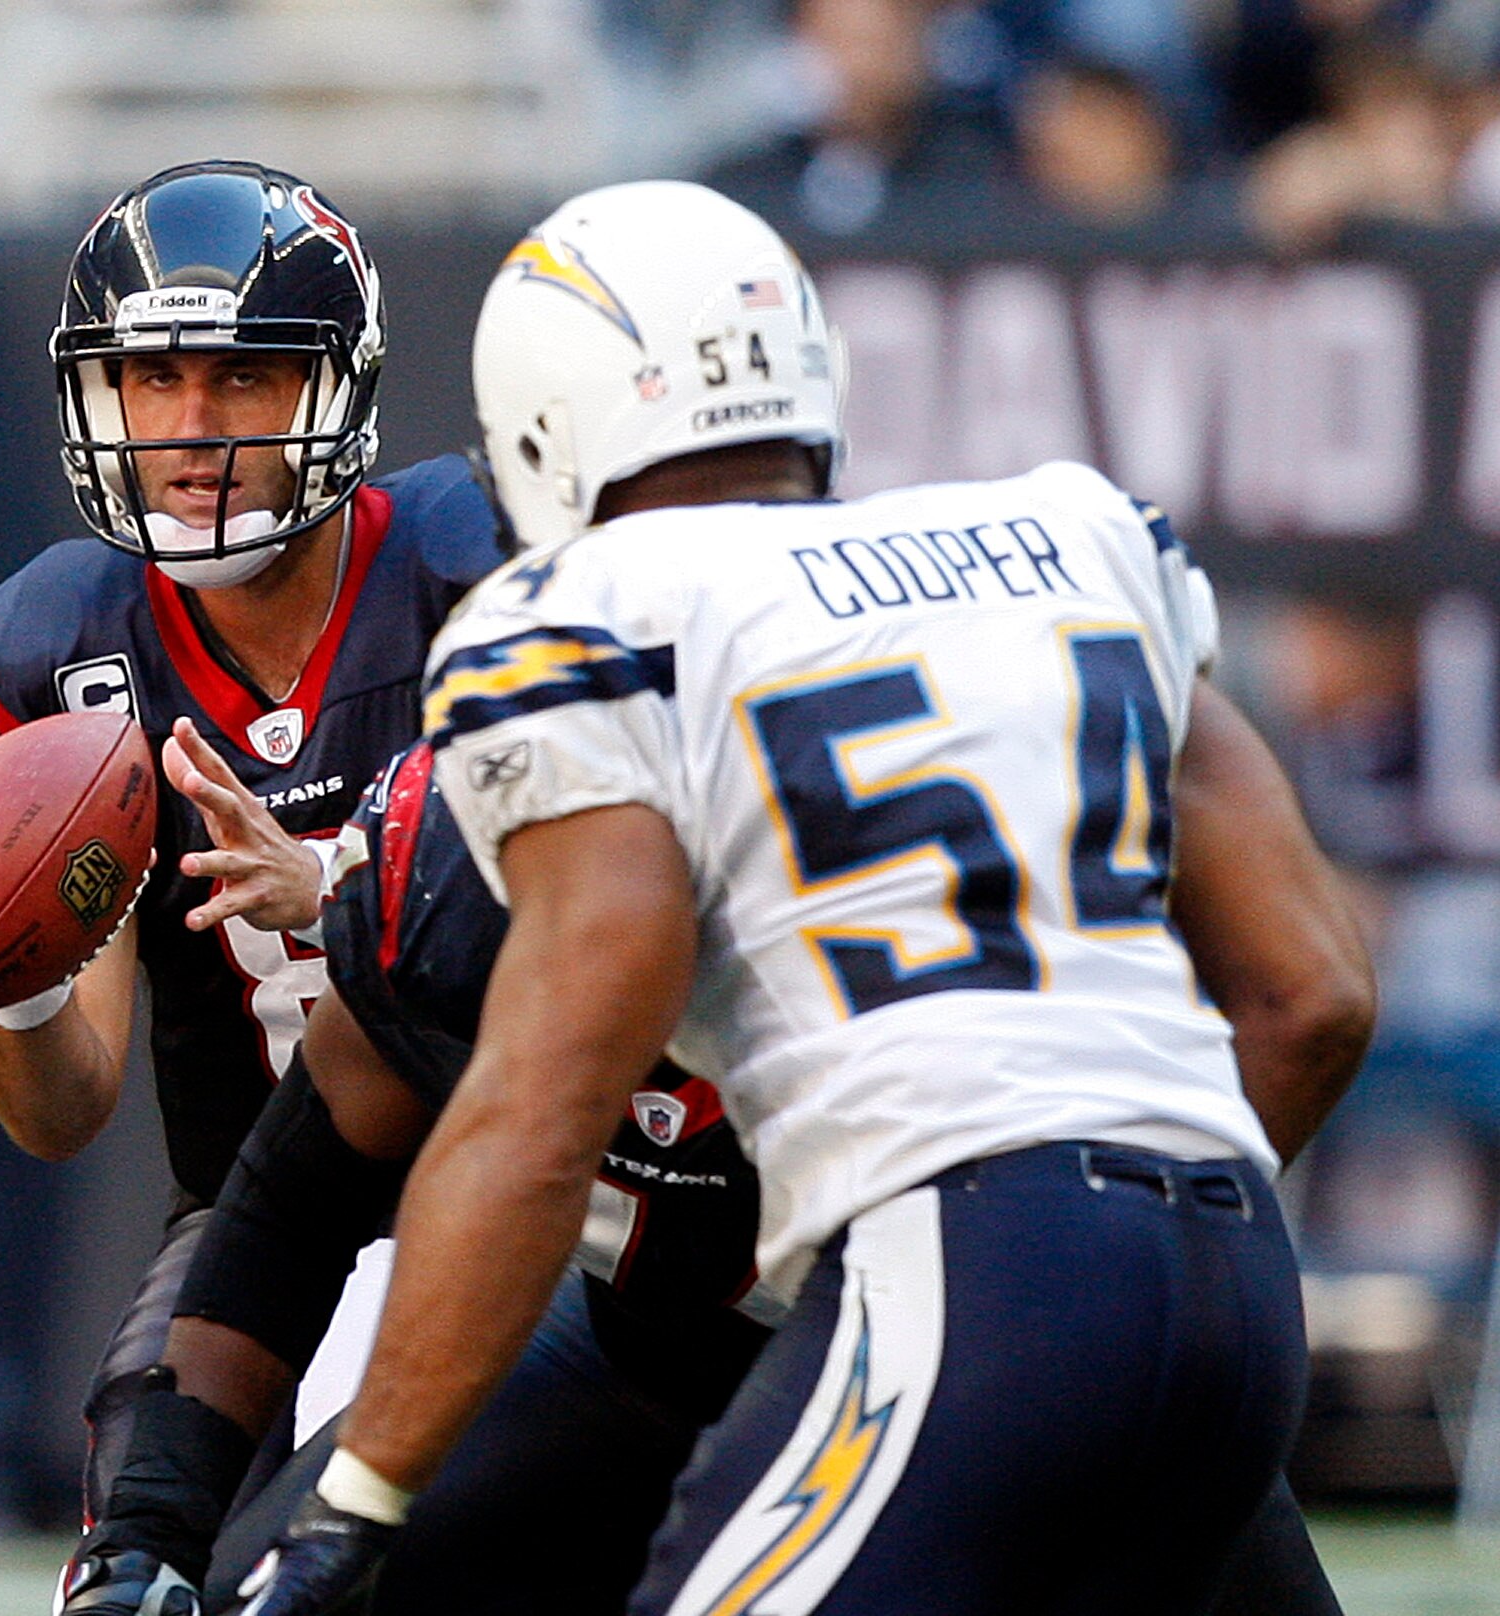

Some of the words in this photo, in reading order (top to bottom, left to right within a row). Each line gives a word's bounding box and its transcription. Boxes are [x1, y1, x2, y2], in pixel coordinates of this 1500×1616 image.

[697, 333, 770, 387] 54
[789, 517, 1081, 619] COOPER
[63, 664, 130, 715] C
[732, 621, 1228, 1022] 54
[66, 848, 113, 907] NFL
[604, 1151, 728, 1188] TEXANS
